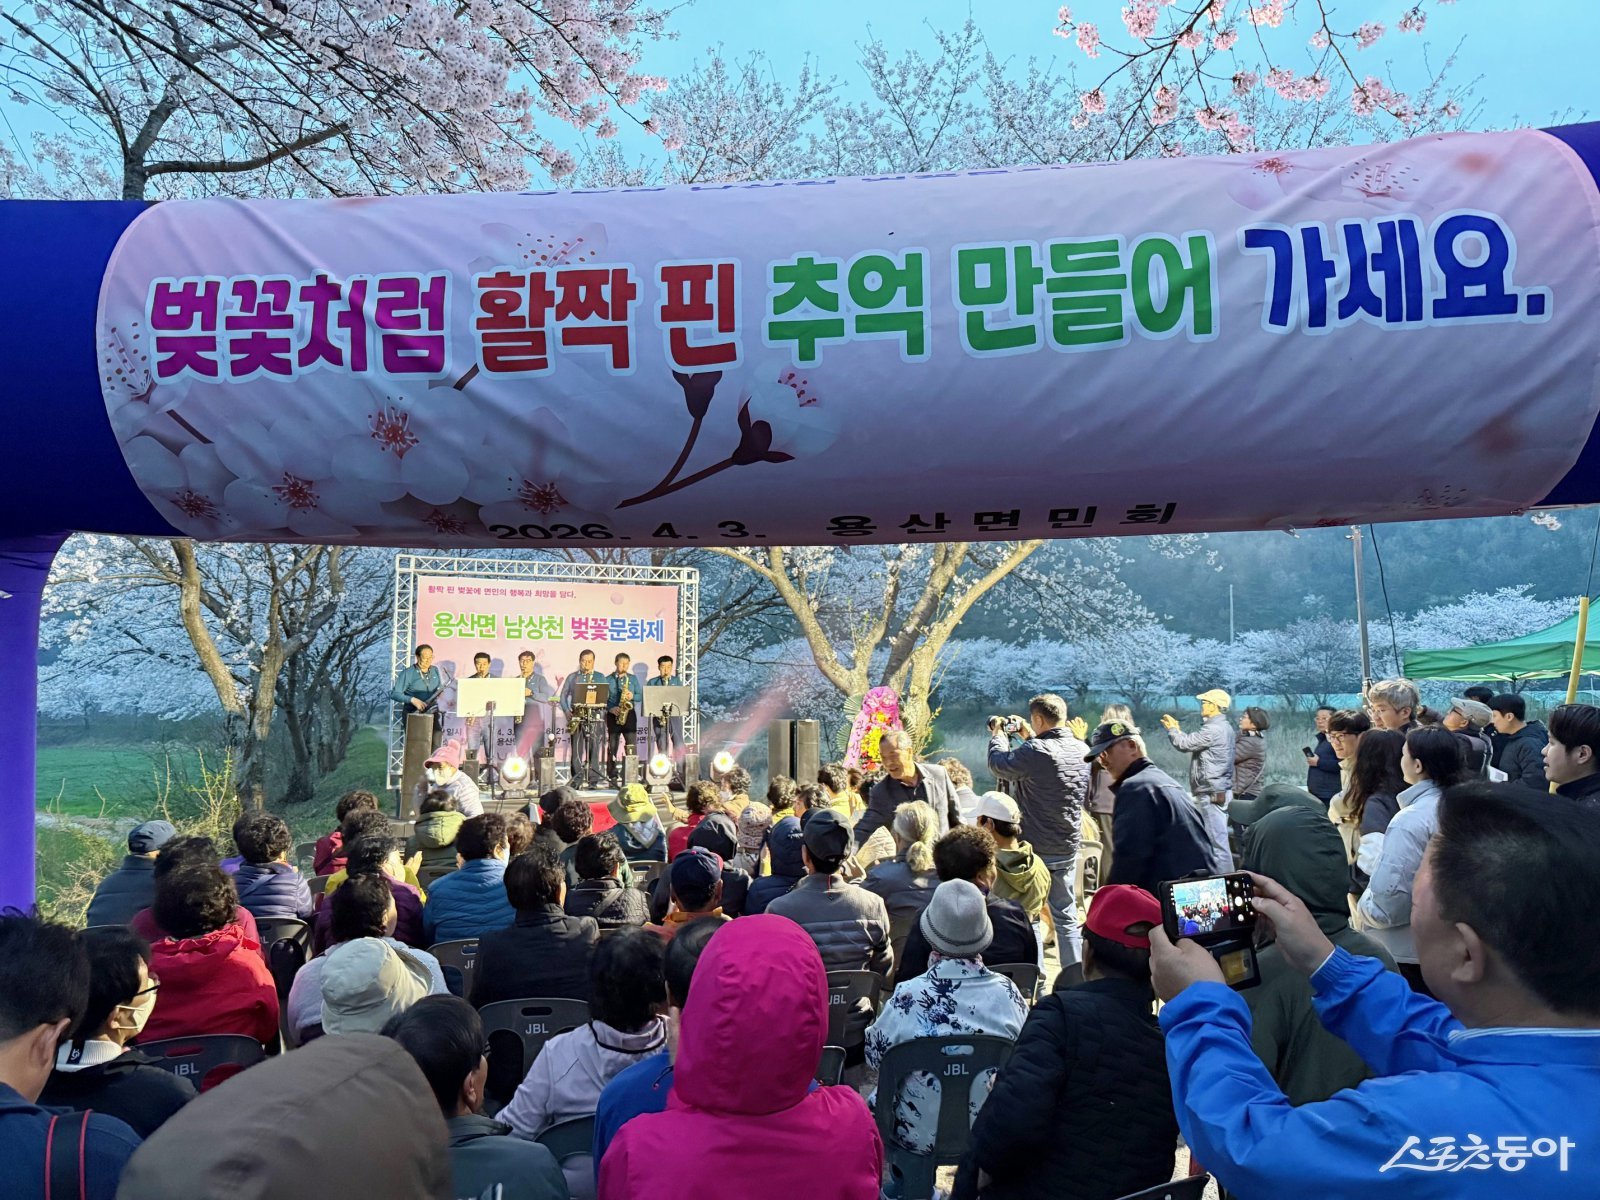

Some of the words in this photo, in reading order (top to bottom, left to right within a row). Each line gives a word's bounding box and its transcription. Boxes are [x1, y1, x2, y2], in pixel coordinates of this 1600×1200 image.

[149, 272, 447, 378] 벚꽃처럼
[475, 263, 637, 374] 활짝
[659, 262, 738, 368] 핀
[768, 247, 925, 363] 추억
[957, 233, 1213, 351] 만들어
[1245, 213, 1546, 327] 가세요.
[488, 523, 632, 540] 2026.
[651, 521, 699, 539] 4.
[717, 520, 767, 538] 3.
[432, 611, 497, 639] 용산면
[504, 614, 564, 640] 남상천
[571, 616, 665, 643] 벚꽃문화제
[828, 994, 847, 1005] JBL
[525, 1023, 550, 1035] JBL
[943, 1063, 970, 1076] JBL
